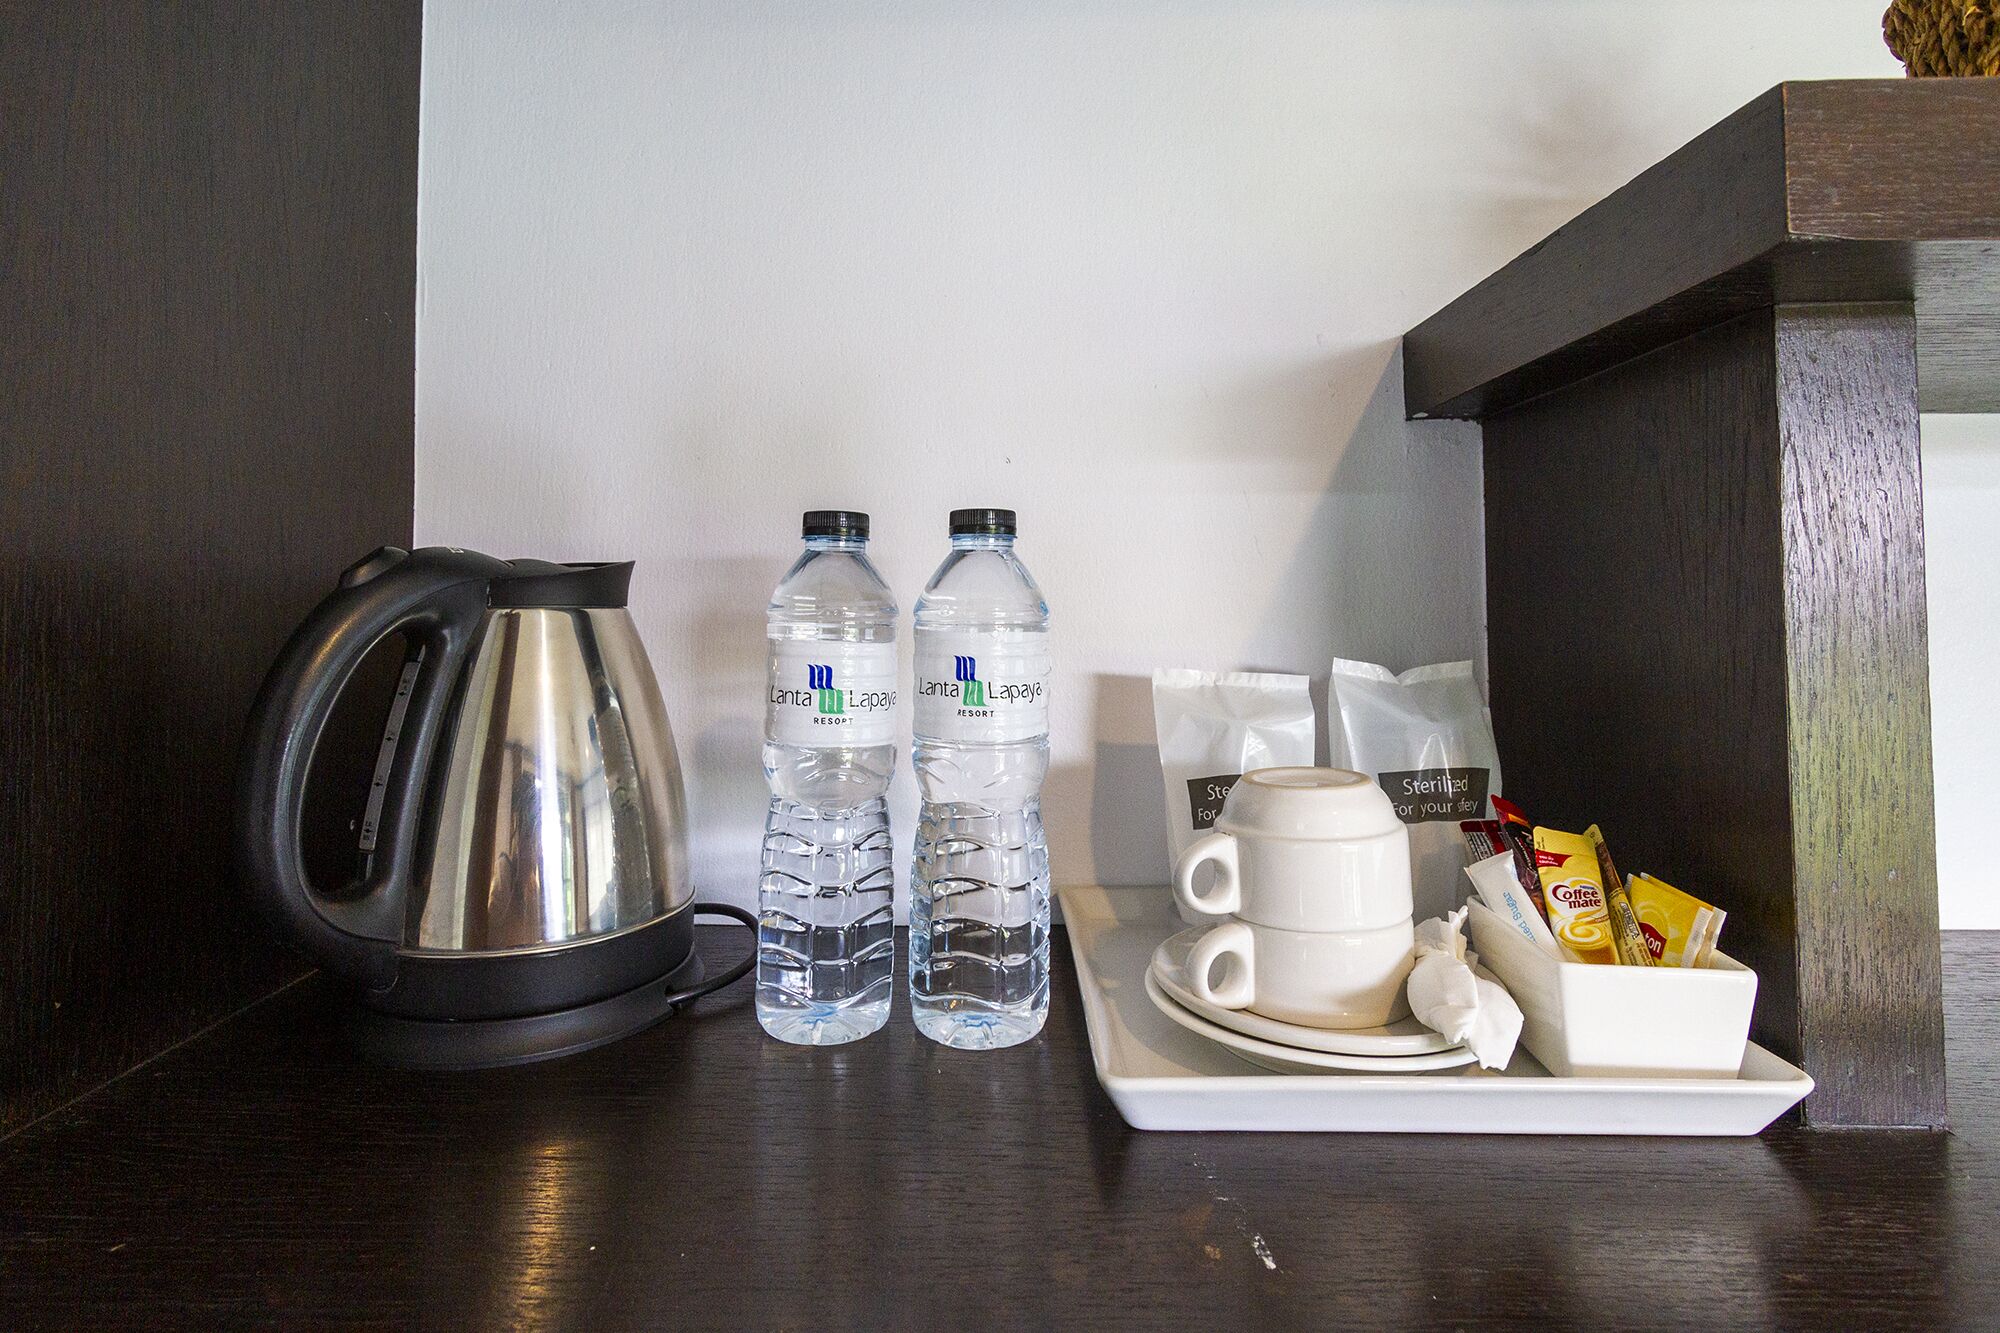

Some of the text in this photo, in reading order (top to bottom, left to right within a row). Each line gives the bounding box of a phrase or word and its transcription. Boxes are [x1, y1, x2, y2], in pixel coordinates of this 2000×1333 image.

[770, 684, 812, 707] Lanta
[918, 676, 1042, 704] Lanta Lapaya
[813, 717, 854, 725] RESORT
[957, 708, 995, 718] RESORT
[1207, 784, 1231, 801] Ste
[1197, 807, 1217, 821] For
[1420, 802, 1453, 818] your
[1551, 884, 1599, 903] Coffee
[1503, 891, 1522, 921] Sugar
[1568, 898, 1602, 909] mate
[1645, 932, 1662, 953] ton
